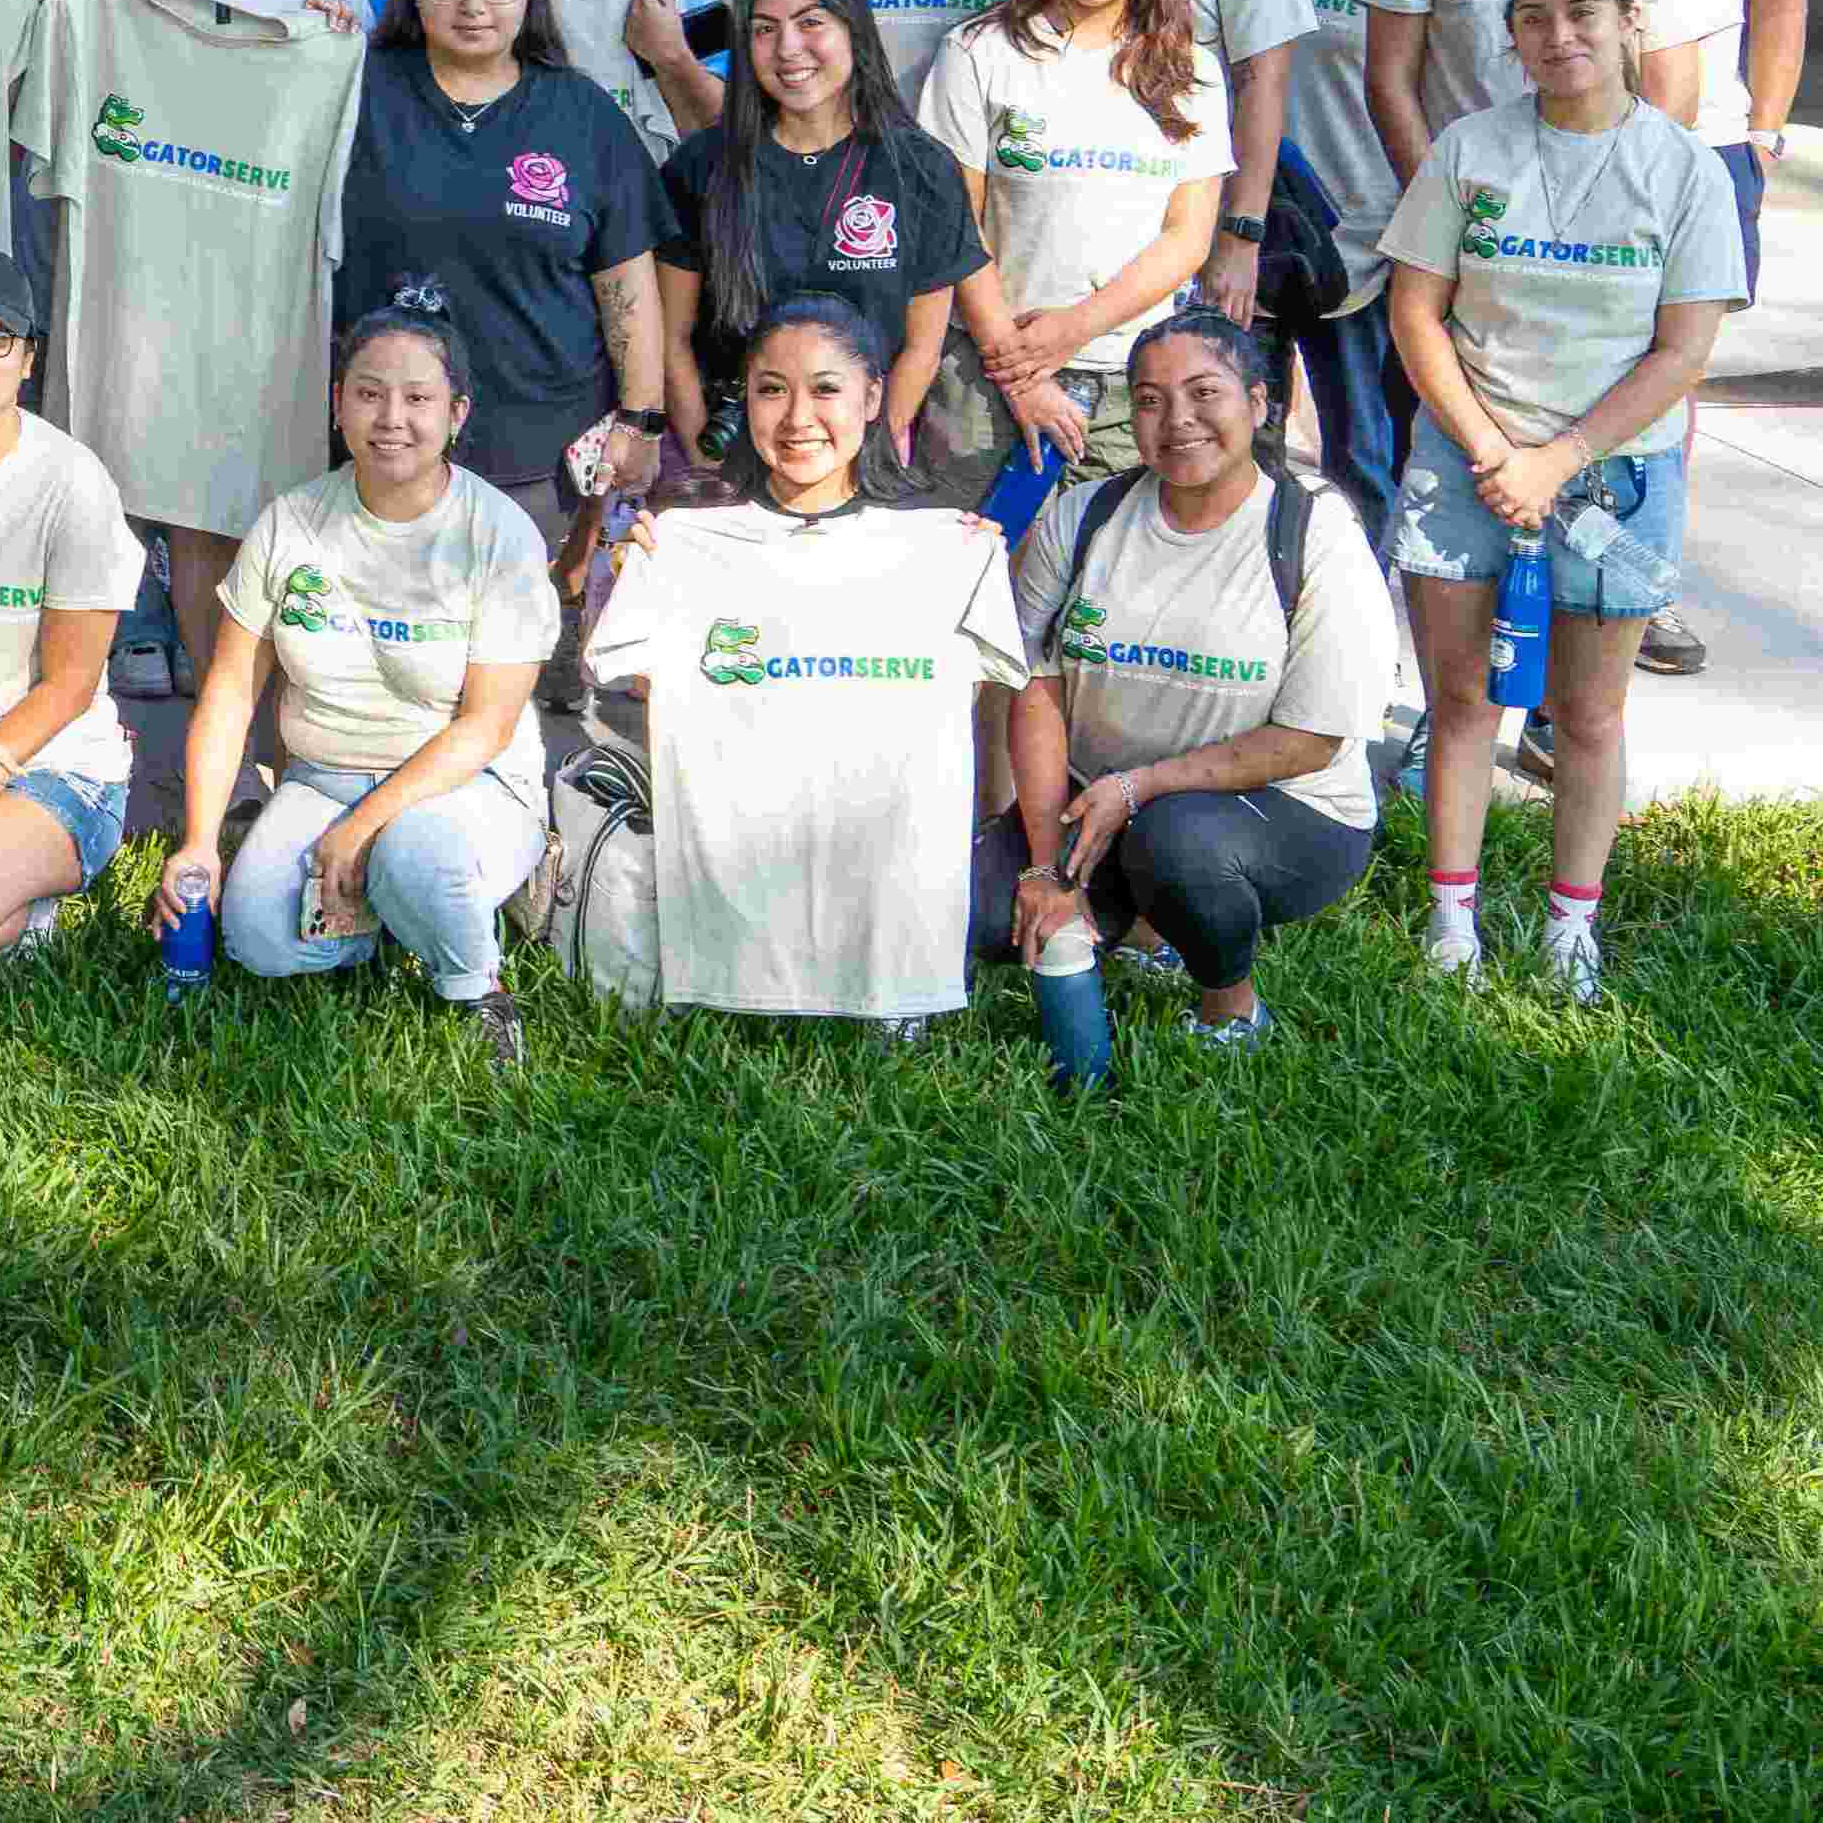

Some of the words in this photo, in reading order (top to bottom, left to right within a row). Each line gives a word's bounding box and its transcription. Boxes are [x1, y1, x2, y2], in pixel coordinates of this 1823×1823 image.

[145, 139, 291, 191] GATORSERVE
[505, 202, 571, 227] VOLUNTEER
[827, 258, 898, 272] VOLUNTEER
[766, 656, 935, 681] GATORSERVE
[1109, 642, 1267, 681] GATORSERVE
